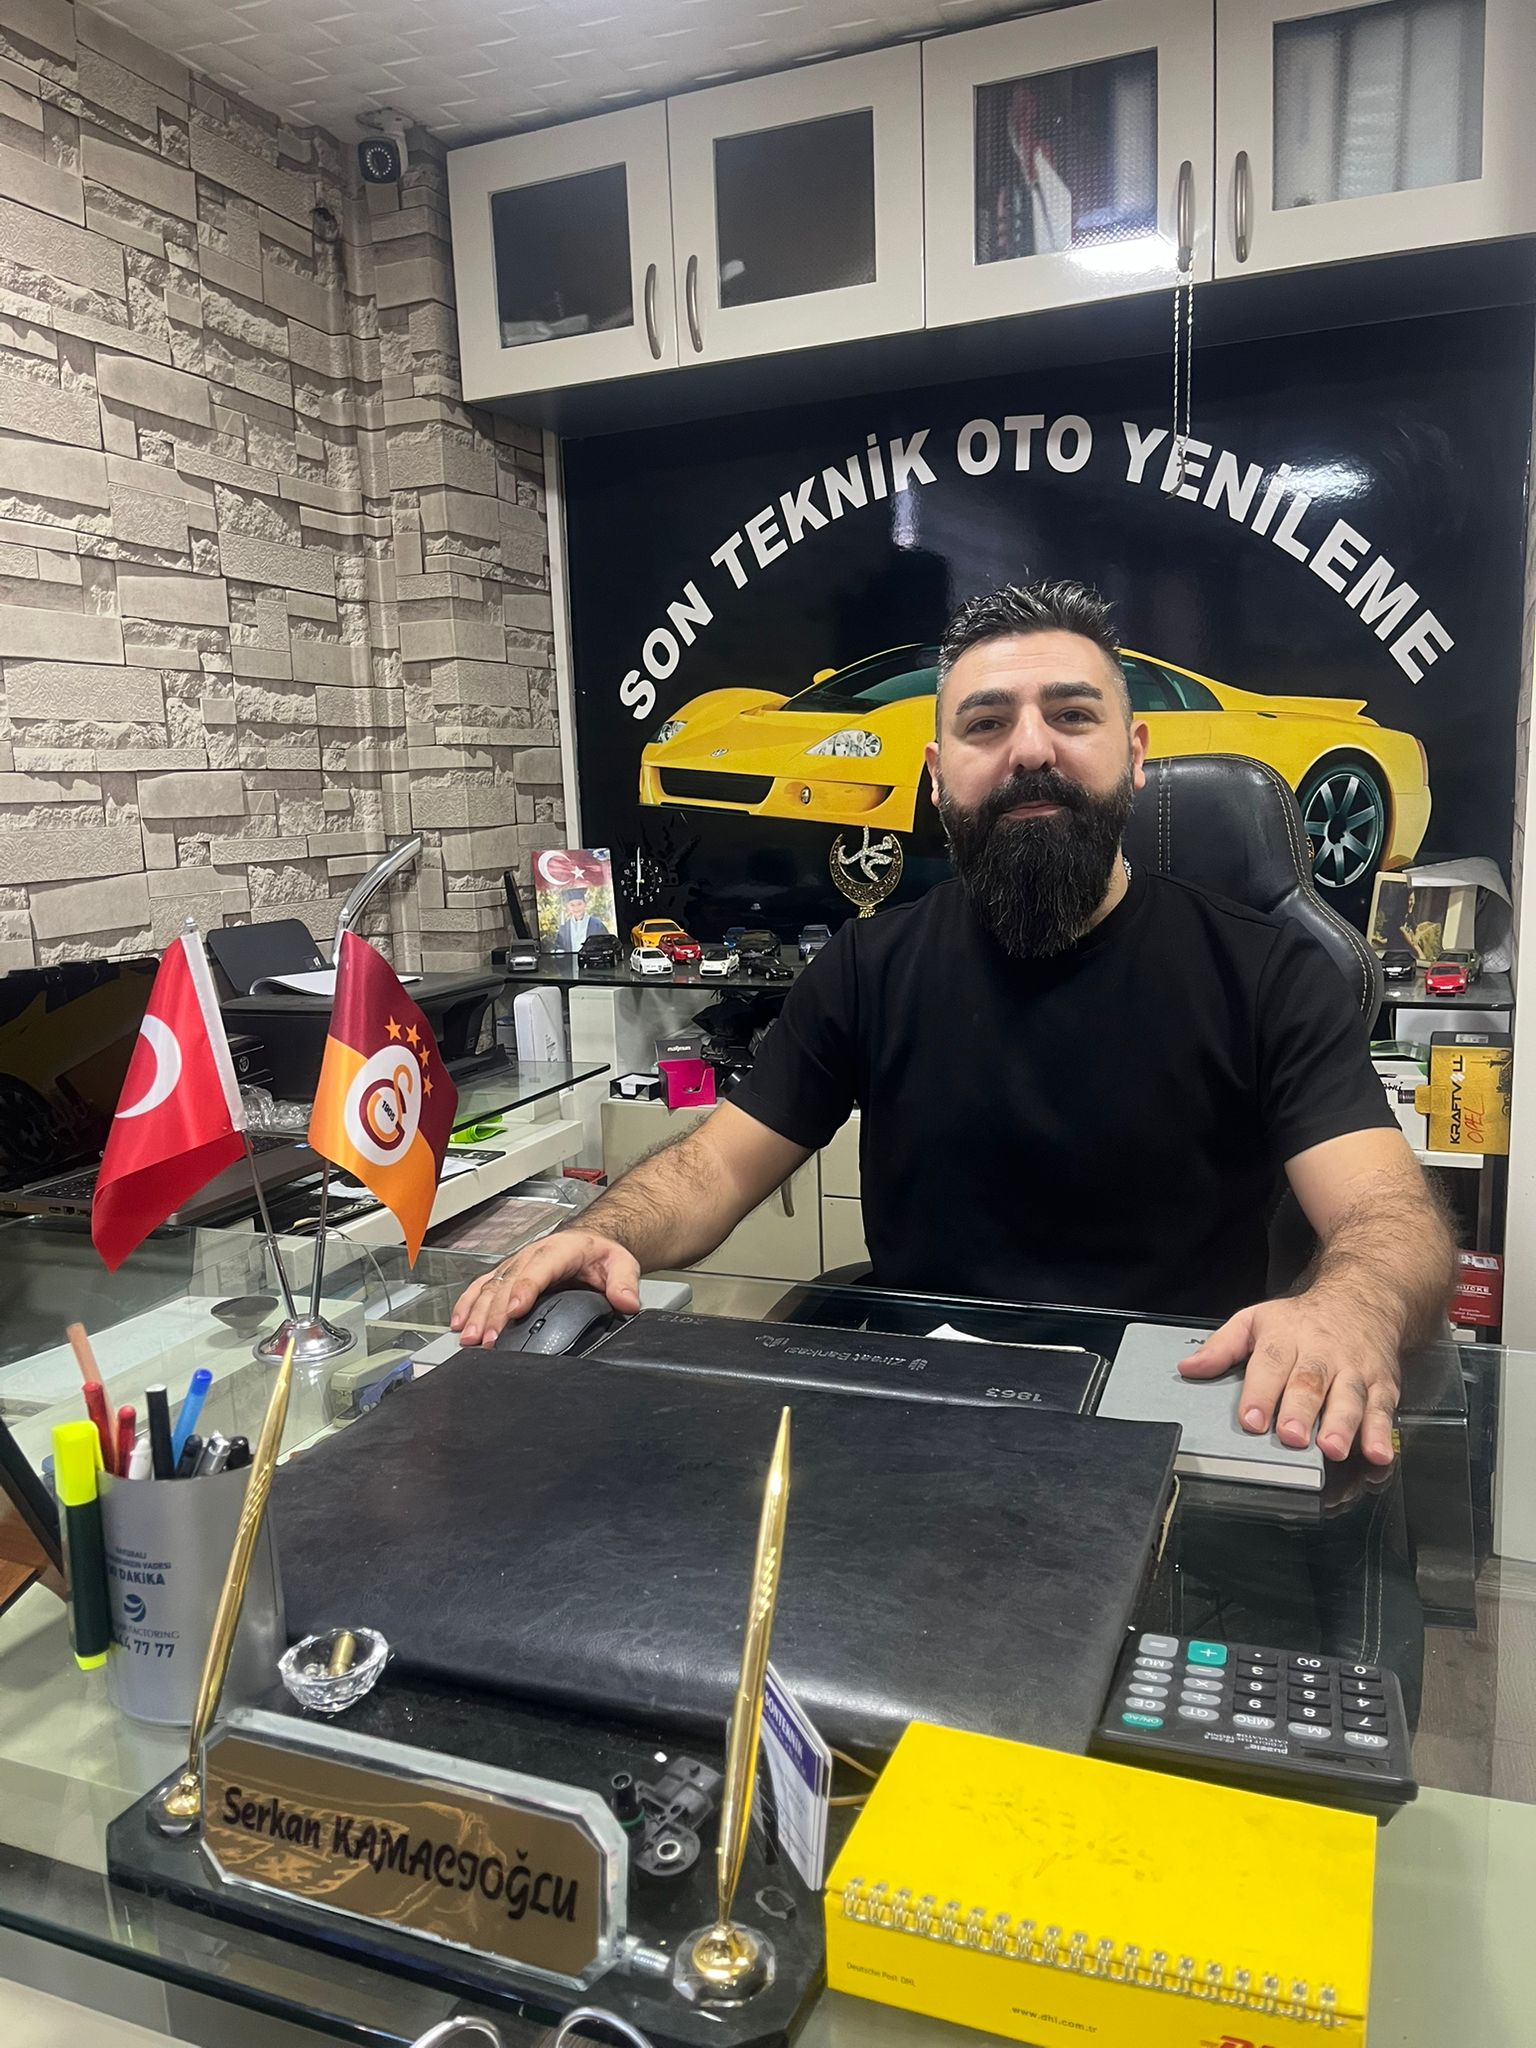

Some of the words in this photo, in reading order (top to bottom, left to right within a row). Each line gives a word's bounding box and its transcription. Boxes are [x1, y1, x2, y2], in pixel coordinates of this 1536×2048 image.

[618, 582, 713, 720] SON
[710, 428, 938, 590] TEKNİK
[955, 414, 1092, 477] OTO
[1122, 421, 1456, 685] YENİLEME
[381, 1100, 396, 1122] 1905
[1463, 1094, 1486, 1144] OPEL
[984, 1386, 1043, 1403] 1863
[134, 1640, 150, 1655] 77
[155, 1643, 175, 1658] 77
[1142, 1657, 1165, 1668] MU
[1251, 1666, 1264, 1675] 3
[1353, 1665, 1367, 1675] 0
[1302, 1673, 1316, 1684] 2
[1250, 1681, 1263, 1692] 6
[1357, 1681, 1368, 1691] 1
[1303, 1690, 1316, 1700] 5
[1133, 1698, 1157, 1709] CE
[1248, 1699, 1262, 1709] 9
[1356, 1698, 1371, 1707] 4
[1186, 1707, 1209, 1718] GT
[1303, 1707, 1316, 1718] 8
[1237, 1714, 1269, 1727] MRC
[1358, 1716, 1372, 1728] 7
[1350, 1732, 1379, 1745] M+
[223, 1786, 321, 1850] Serkan
[845, 1962, 882, 1979] Deutsche
[882, 1969, 898, 1983] Post
[899, 1975, 917, 1988] DHL
[1011, 2005, 1099, 2035] www.dhl.com.tr
